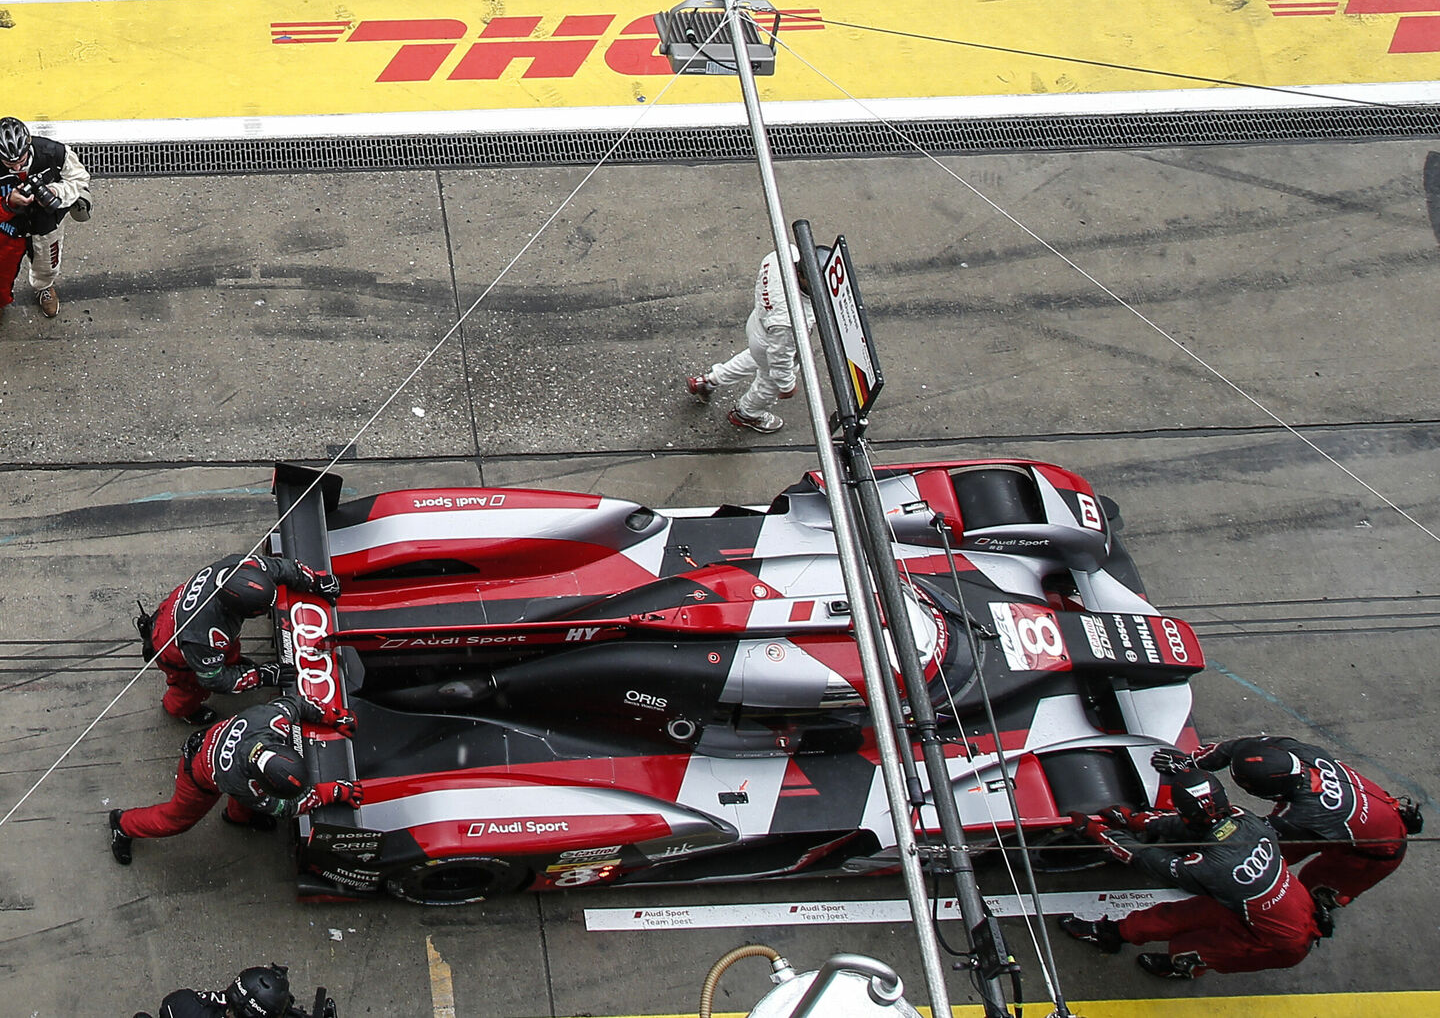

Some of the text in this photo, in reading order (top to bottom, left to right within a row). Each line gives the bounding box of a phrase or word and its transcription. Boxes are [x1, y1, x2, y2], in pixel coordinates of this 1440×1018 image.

[828, 255, 845, 298] 8
[413, 496, 488, 508] Audi Sport
[1083, 499, 1101, 524] P1
[990, 537, 1050, 547] Audi Sport
[565, 627, 601, 642] HY
[935, 618, 946, 650] Audi
[1016, 615, 1063, 657] 8
[1083, 615, 1102, 650] Castrol
[1094, 615, 1117, 660] EDGE
[1112, 614, 1132, 649] BOSCH
[410, 634, 526, 646] Audi Sport
[1132, 615, 1160, 664] MAHLE
[626, 690, 668, 708] ORIS
[488, 821, 569, 834] Audi Sport
[331, 841, 379, 849] ORIS
[336, 867, 380, 881] MAHLE
[555, 868, 595, 887] 8
[1109, 891, 1154, 901] Audi Sport
[1271, 888, 1288, 905] Audi
[799, 903, 846, 914] Audi Sport
[1110, 901, 1134, 909] Team
[644, 908, 690, 919] Audi Sport
[801, 912, 848, 922] Team Joest
[645, 917, 693, 927] Team Joest
[234, 976, 267, 1017] Audi Sport
